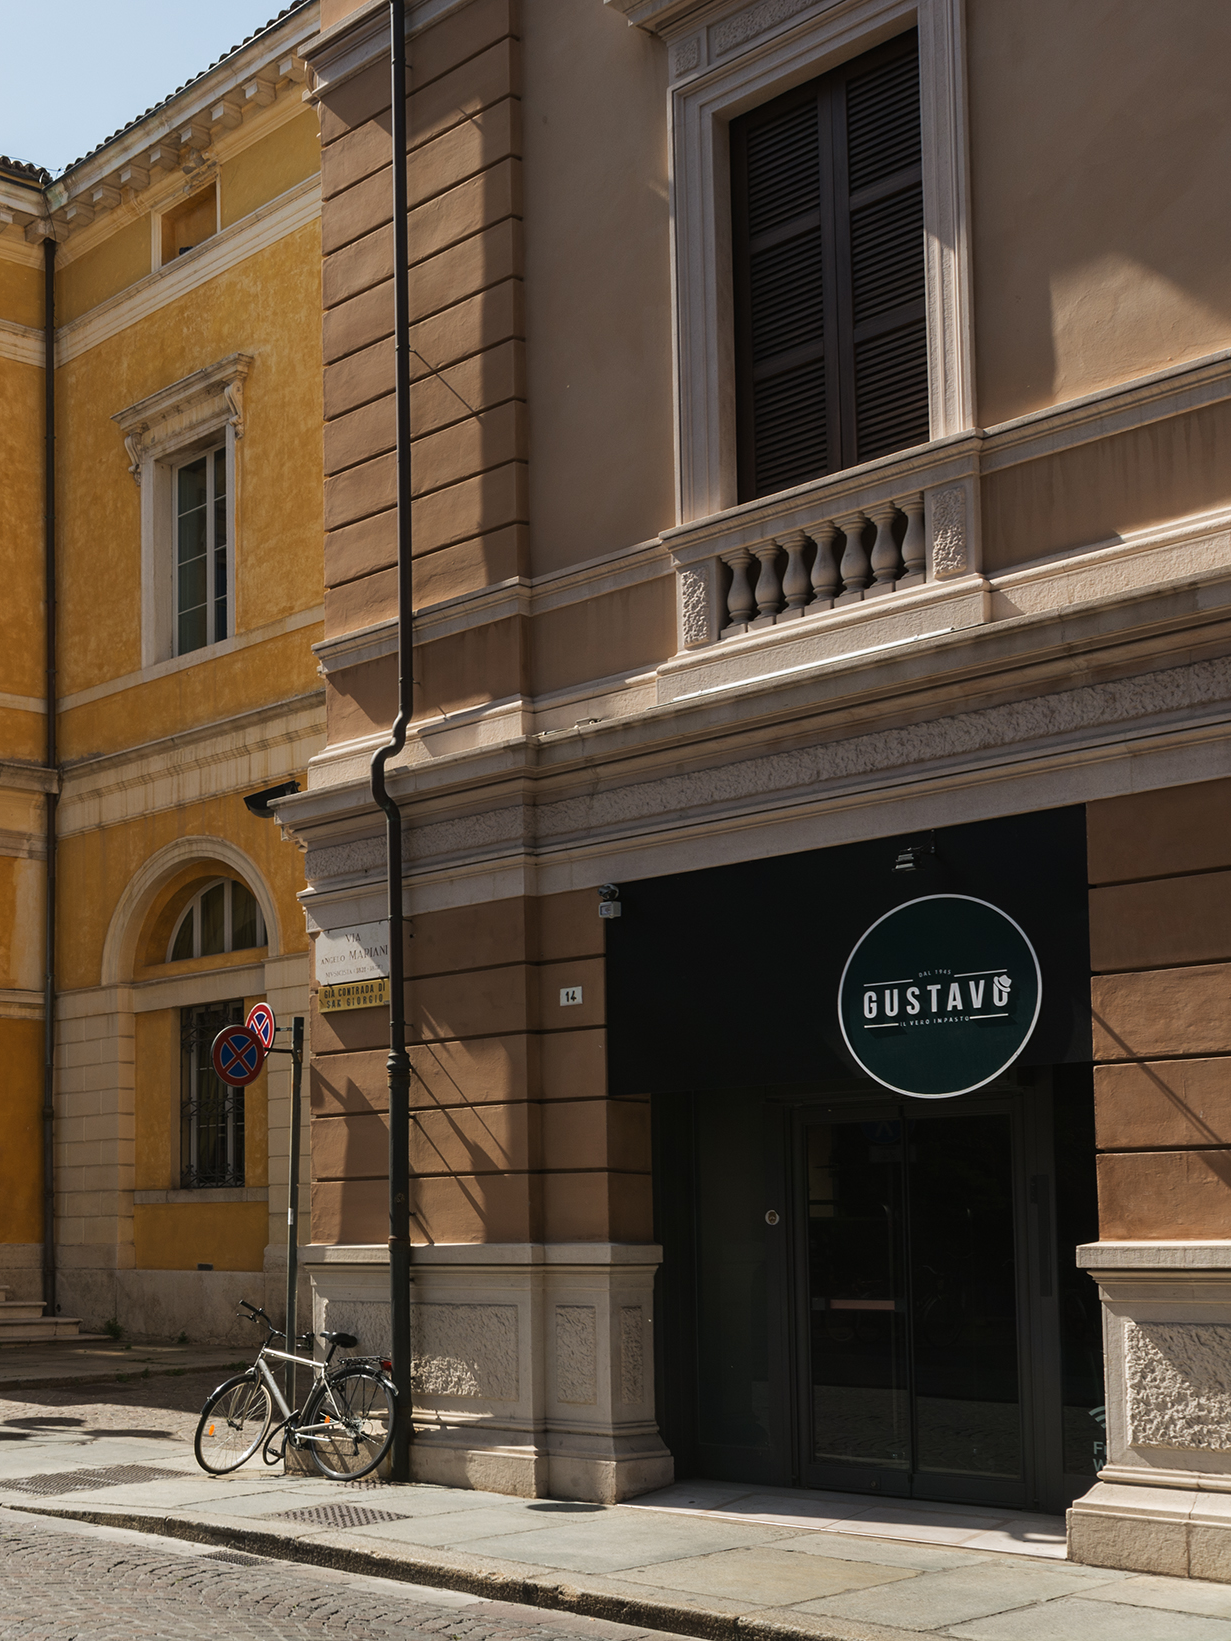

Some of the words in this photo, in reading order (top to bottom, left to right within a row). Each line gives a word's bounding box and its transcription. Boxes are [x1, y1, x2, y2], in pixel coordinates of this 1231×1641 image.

[345, 933, 361, 942] VIA
[321, 955, 345, 965] ANGELO
[349, 945, 388, 959] MARIANI
[918, 970, 931, 978] DAL
[338, 984, 374, 997] CONTRADA
[378, 982, 385, 992] DI
[565, 990, 577, 1002] 14
[346, 993, 383, 1007] GIORGIO
[863, 976, 1010, 1019] GUSTAVO
[909, 1018, 930, 1026] VERO
